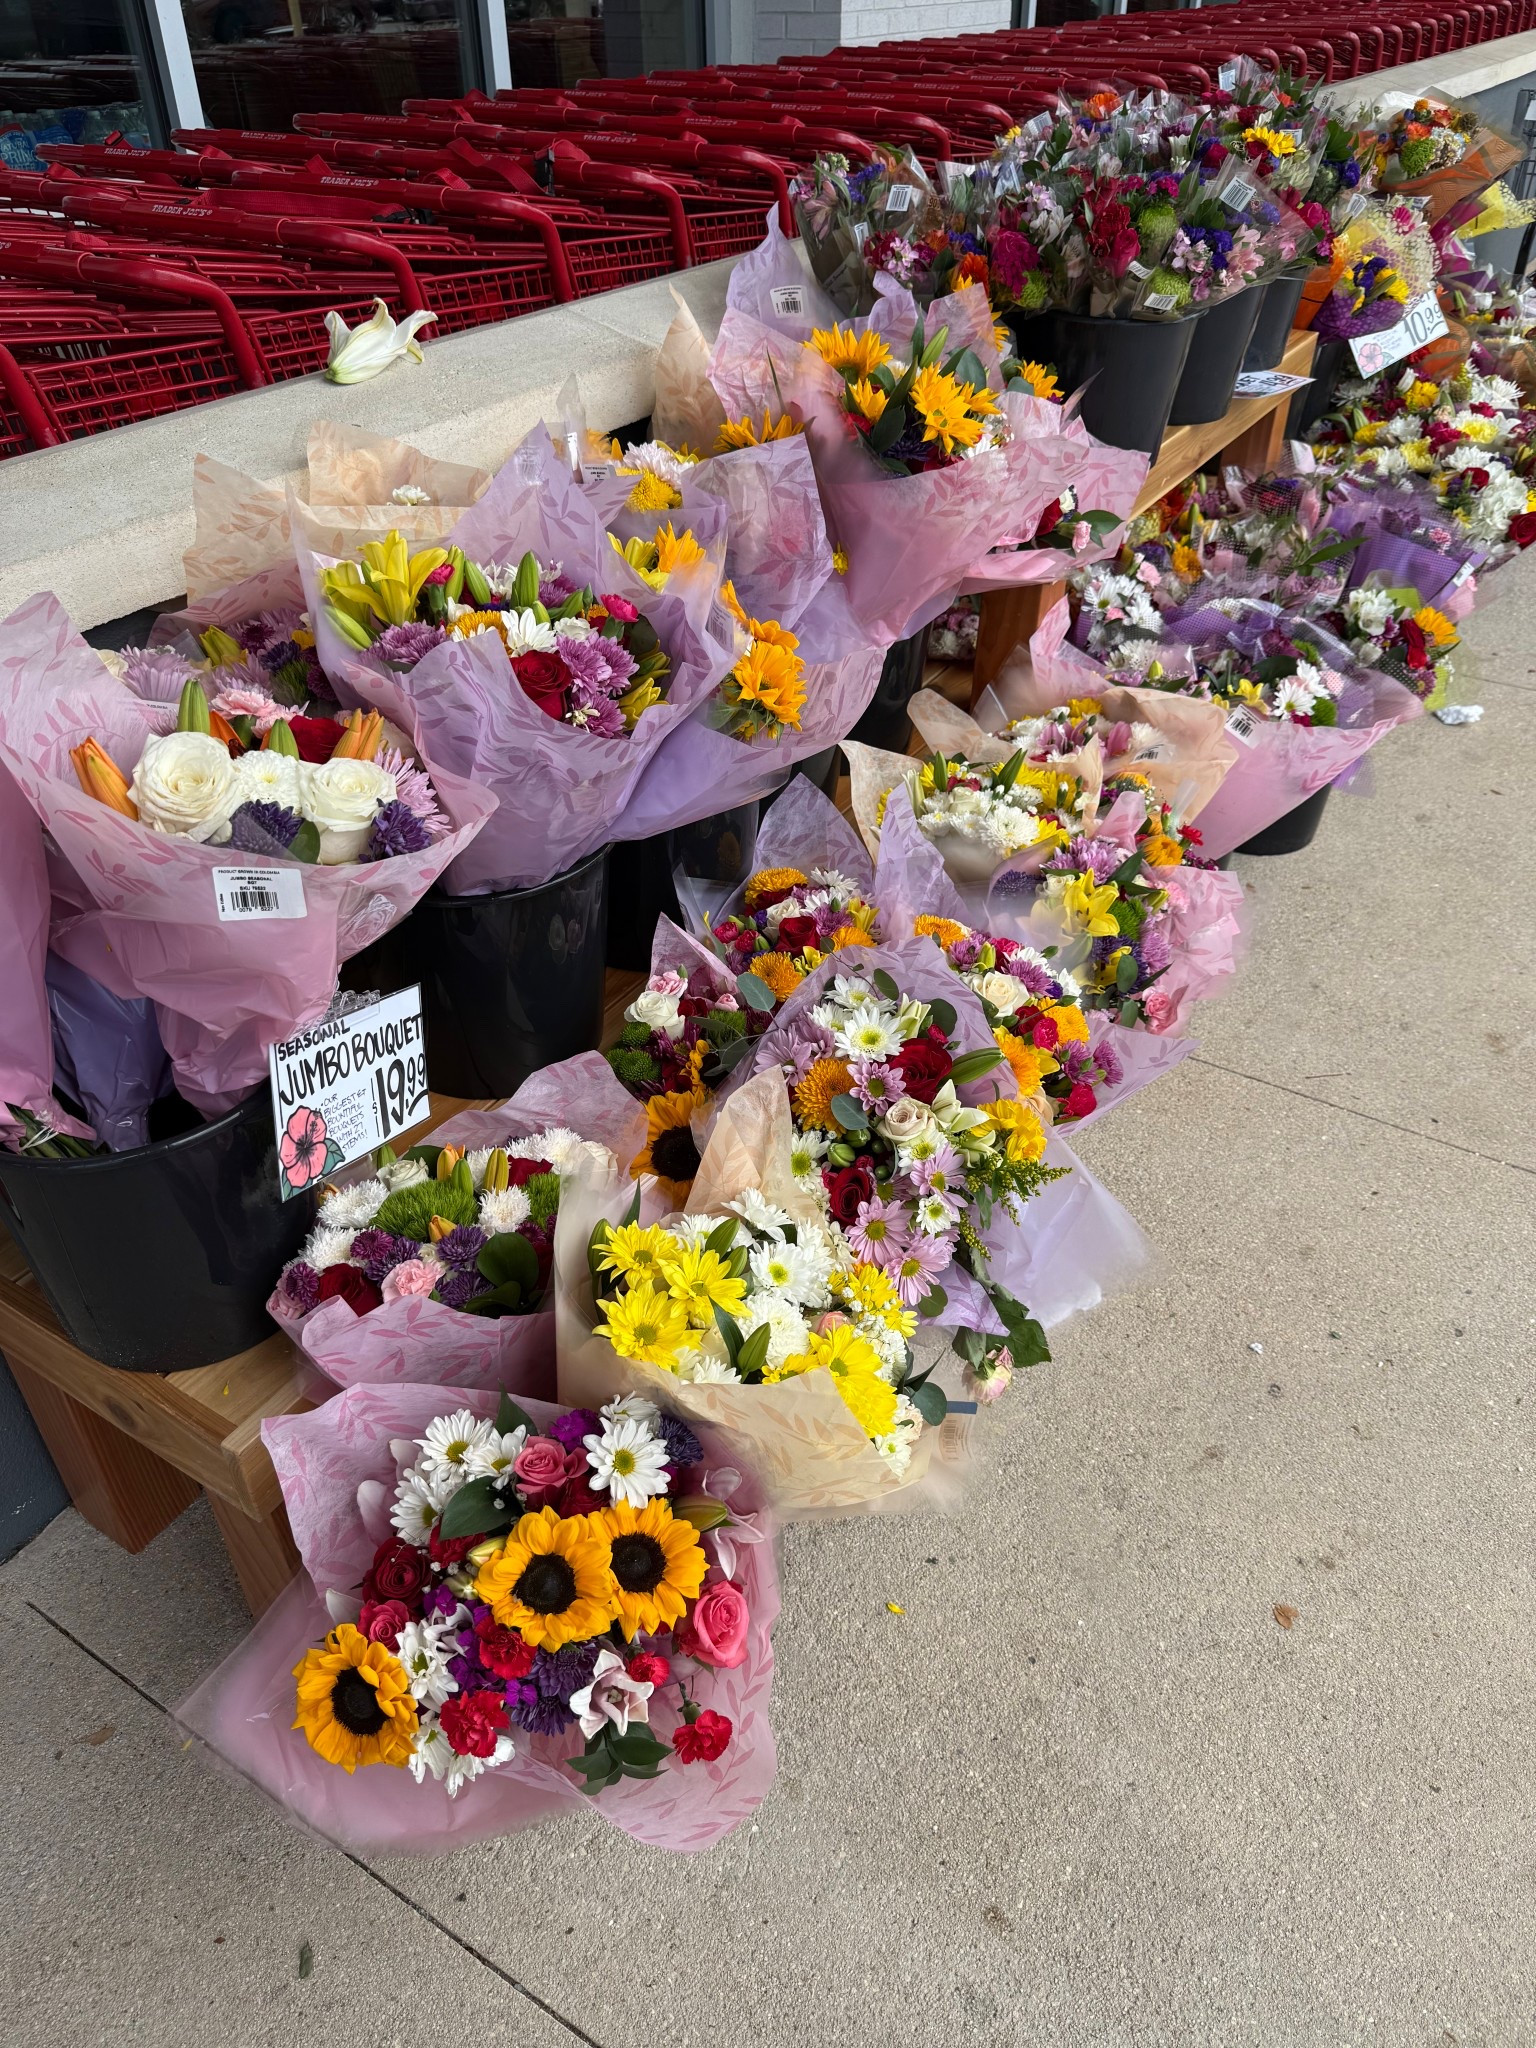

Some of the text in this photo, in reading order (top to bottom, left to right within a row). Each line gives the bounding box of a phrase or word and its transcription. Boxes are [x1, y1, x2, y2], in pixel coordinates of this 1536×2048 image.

[104, 147, 127, 156] TRADER
[320, 176, 351, 186] TRADER
[152, 204, 183, 215] TRADER
[1403, 303, 1443, 346] 10.99
[278, 1019, 351, 1062] SEASONAL
[280, 1013, 422, 1106] JUMBO BOUQUET
[324, 1092, 356, 1119] BIGGEST
[328, 1110, 365, 1138] BOUQUETS
[336, 1128, 352, 1143] WITH
